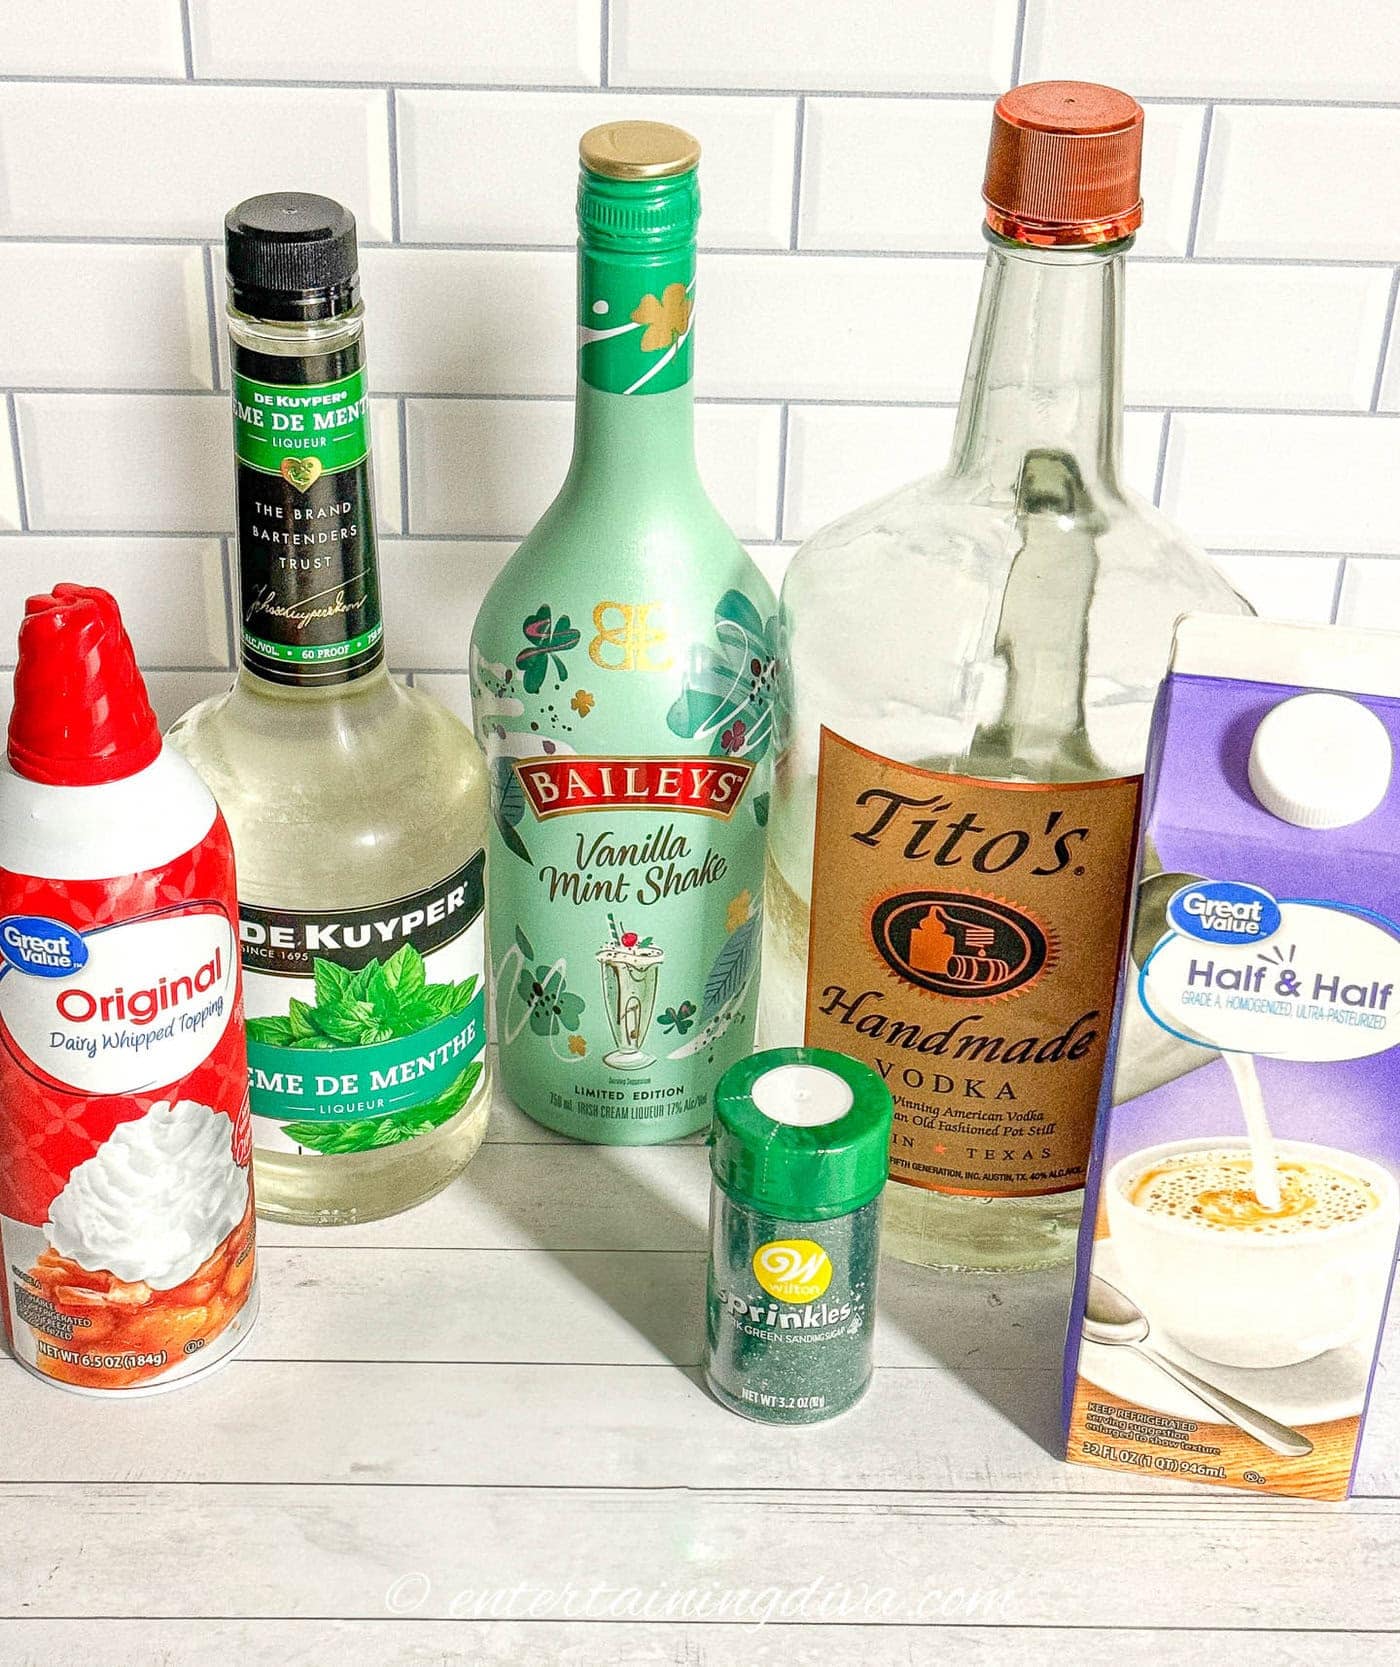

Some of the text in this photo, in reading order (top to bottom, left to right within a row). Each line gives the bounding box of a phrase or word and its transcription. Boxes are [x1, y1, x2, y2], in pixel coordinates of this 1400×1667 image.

[254, 392, 274, 406] DE
[272, 413, 304, 432] DE
[272, 436, 327, 449] LIQUEUR
[255, 501, 352, 520] THE BRAND
[252, 524, 357, 546] BARTENDERS
[279, 556, 332, 570] TRUST
[302, 649, 315, 660] 60
[317, 645, 351, 660] PROOF
[530, 767, 738, 804] BAILEYS
[851, 788, 1090, 877] Tito's
[576, 823, 692, 871] Vanilla
[539, 848, 728, 906] Mint Shake
[1182, 892, 1265, 921] Great
[238, 919, 296, 950] DE
[1199, 914, 1260, 935] Value
[3, 925, 71, 956] Great
[20, 946, 72, 968] Value
[240, 945, 309, 962] SINCE 1695
[56, 946, 223, 1026] Original
[1187, 958, 1394, 1011] Half & Half
[1181, 990, 1213, 1008] GRADE
[49, 995, 224, 1058] Dairy Whipped Topping
[819, 984, 1099, 1065] Handmade
[315, 1075, 359, 1096] DE
[370, 1018, 477, 1091] MENTHE
[875, 1058, 1018, 1100] VODKA
[574, 1085, 685, 1100] LIMITED EDITION
[320, 1098, 385, 1114] LIQUEUR
[577, 1101, 598, 1117] IRISH
[601, 1105, 629, 1119] CREAM
[631, 1104, 664, 1119] LIQUEUR
[667, 1101, 682, 1116] 17%
[941, 1106, 1003, 1122] American
[1006, 1108, 1044, 1121] Vodka
[894, 1112, 1057, 1137] an Old Fashioned Pot Still
[967, 1147, 1051, 1160] TEXAS
[1029, 1171, 1048, 1182] 40%
[769, 1282, 820, 1296] wilton
[745, 1326, 786, 1344] GREEN
[39, 1341, 59, 1359] NET
[60, 1349, 80, 1364] WT
[81, 1354, 102, 1368] 6.5
[104, 1357, 121, 1369] OZ
[742, 1387, 759, 1404] NET
[760, 1393, 777, 1408] WT
[1087, 1402, 1198, 1433] KEEP REFRIGERATED
[1087, 1413, 1189, 1441] serving suggestion
[1085, 1423, 1221, 1456] enlarged to show texture
[1083, 1442, 1101, 1457] 32
[1102, 1445, 1118, 1461] FL
[1119, 1450, 1138, 1465] OZ
[1155, 1456, 1179, 1473] QT)
[1180, 1460, 1227, 1479] 946mL
